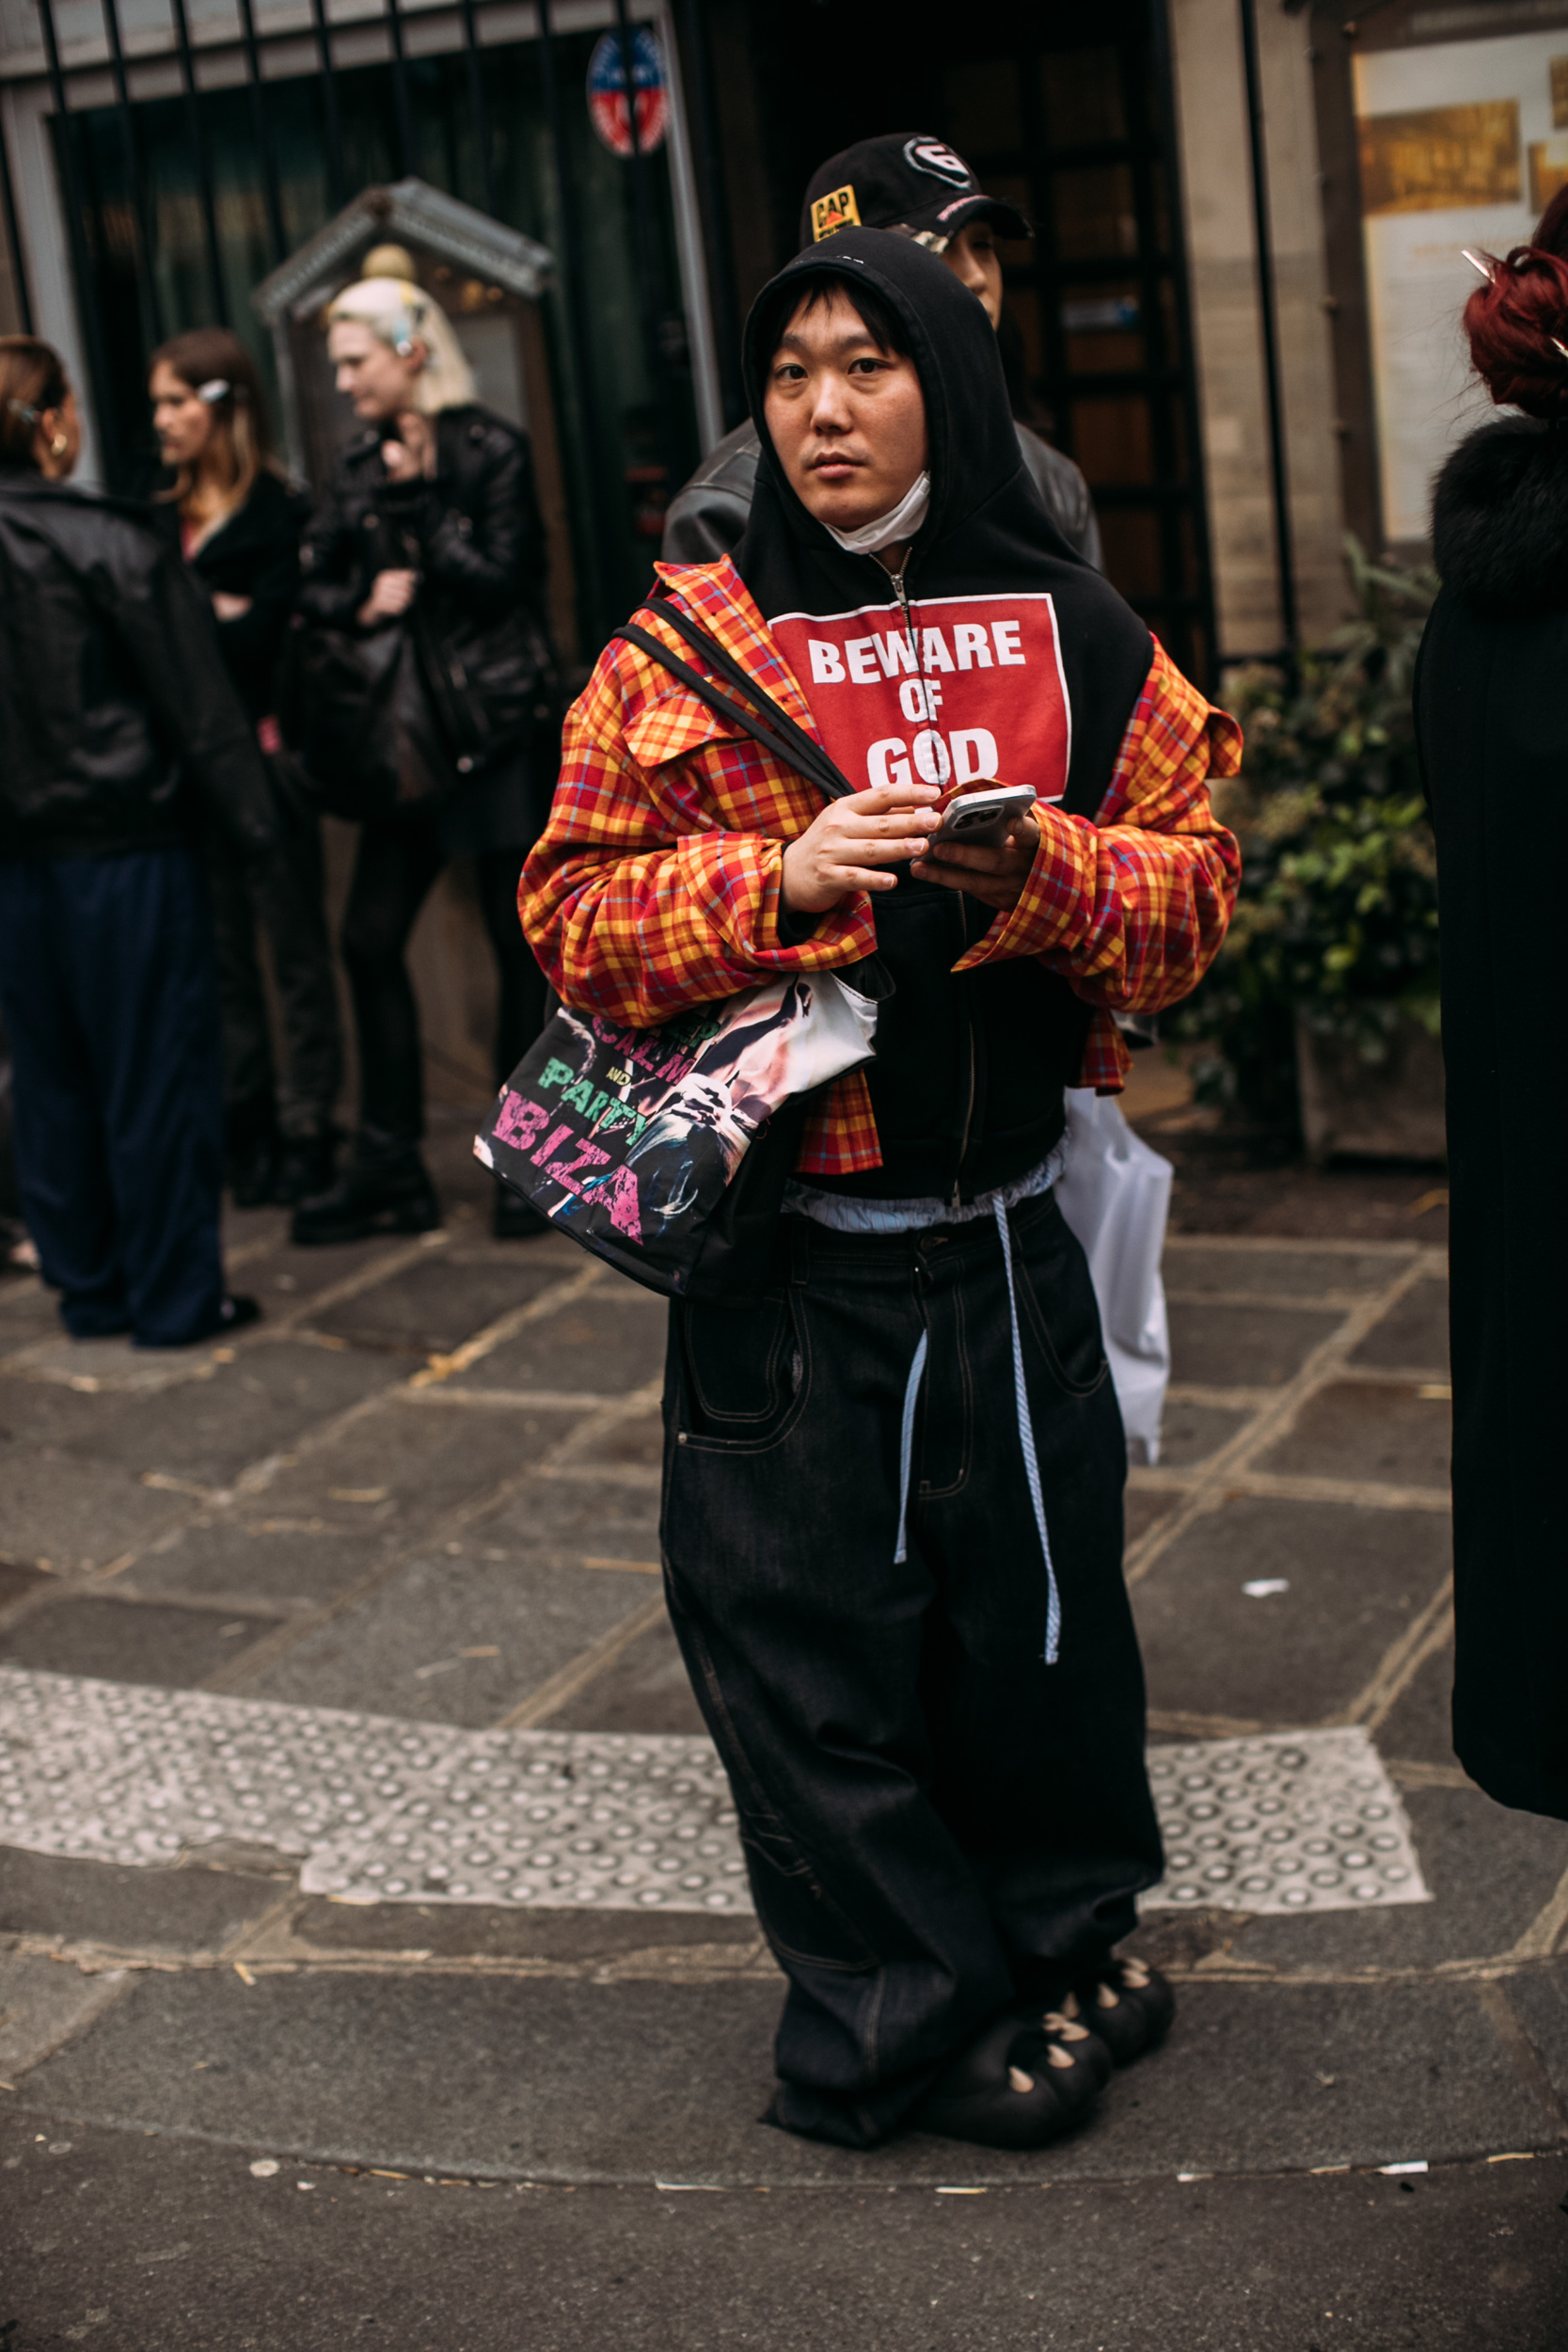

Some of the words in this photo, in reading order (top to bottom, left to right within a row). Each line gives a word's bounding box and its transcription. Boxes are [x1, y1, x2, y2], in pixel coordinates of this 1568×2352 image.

[816, 191, 849, 229] CAP
[807, 620, 1026, 685] BEWARE
[898, 678, 943, 723] OF
[866, 727, 999, 788] GOD
[592, 1015, 697, 1086] CALM
[605, 1065, 633, 1088] AND
[537, 1057, 649, 1147] PARTY
[491, 1089, 644, 1247] BIZA
